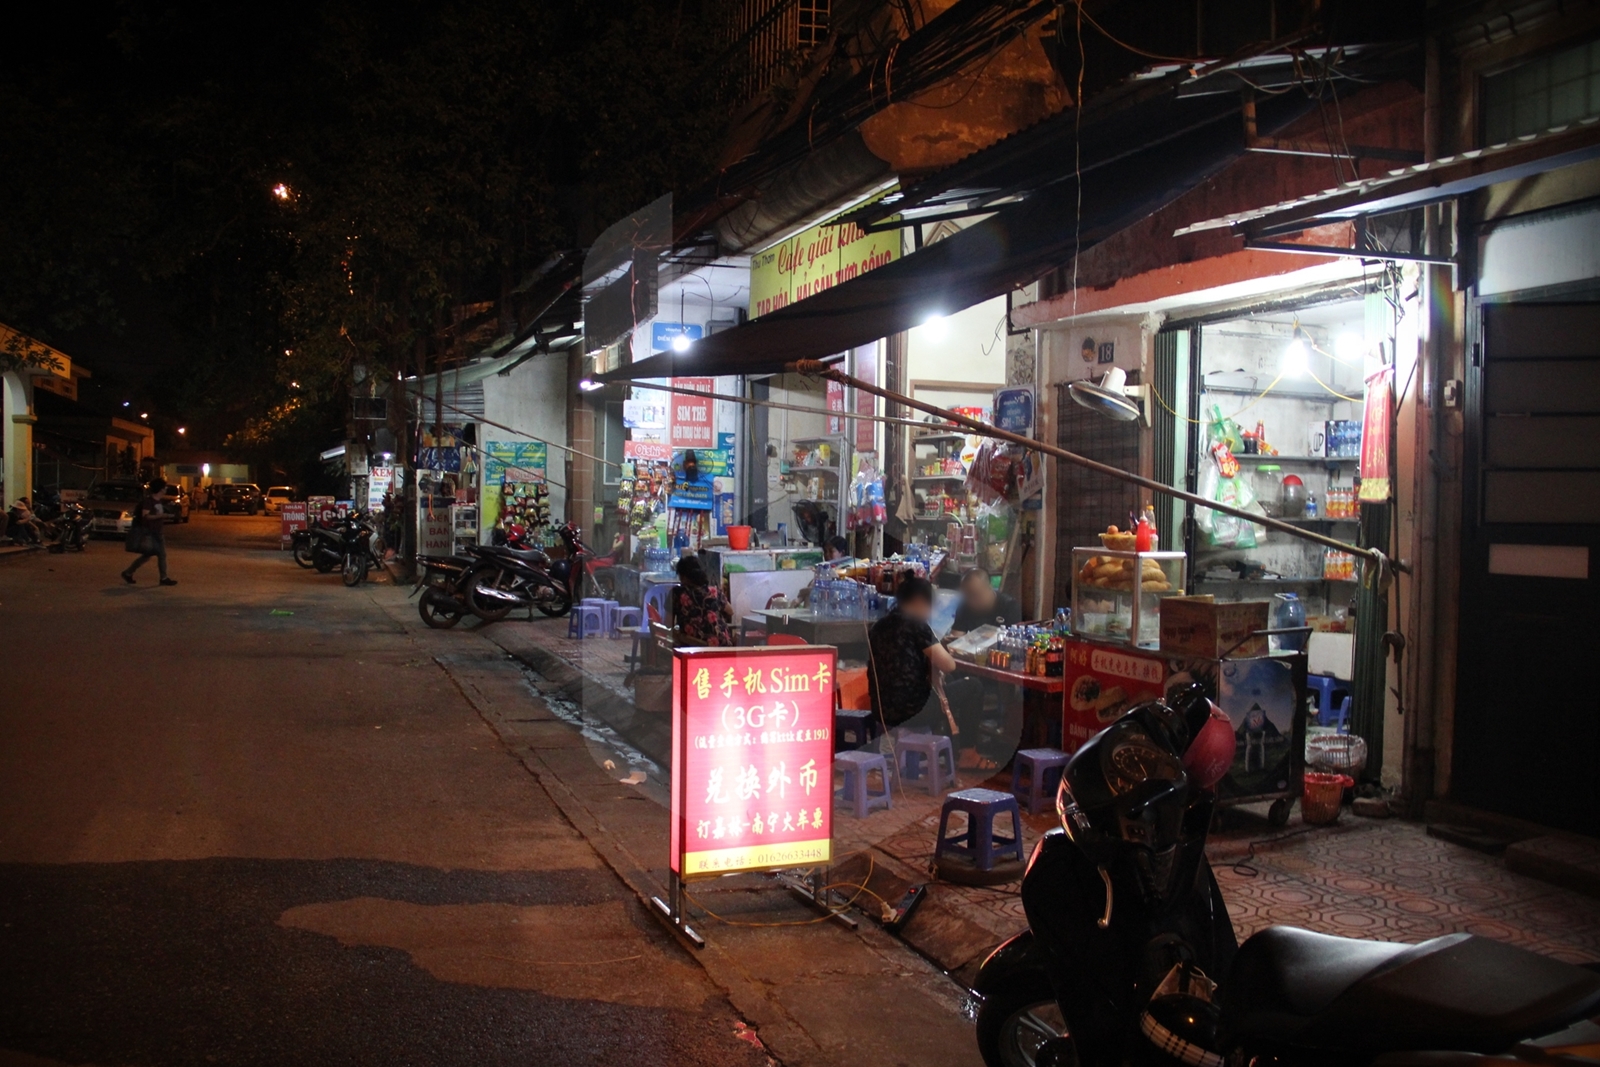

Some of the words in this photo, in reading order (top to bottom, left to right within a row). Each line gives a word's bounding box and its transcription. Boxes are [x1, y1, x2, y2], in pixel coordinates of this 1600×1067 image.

[778, 237, 804, 275] Cafe
[1101, 344, 1112, 362] 18
[677, 405, 691, 421] SIM
[692, 400, 707, 422] THẺ
[635, 444, 661, 457] Oishi
[372, 468, 394, 477] KEM
[289, 524, 298, 533] XE
[426, 538, 449, 548] HÀN
[1069, 722, 1087, 739] BÁNH
[704, 758, 818, 804] 兑换外币
